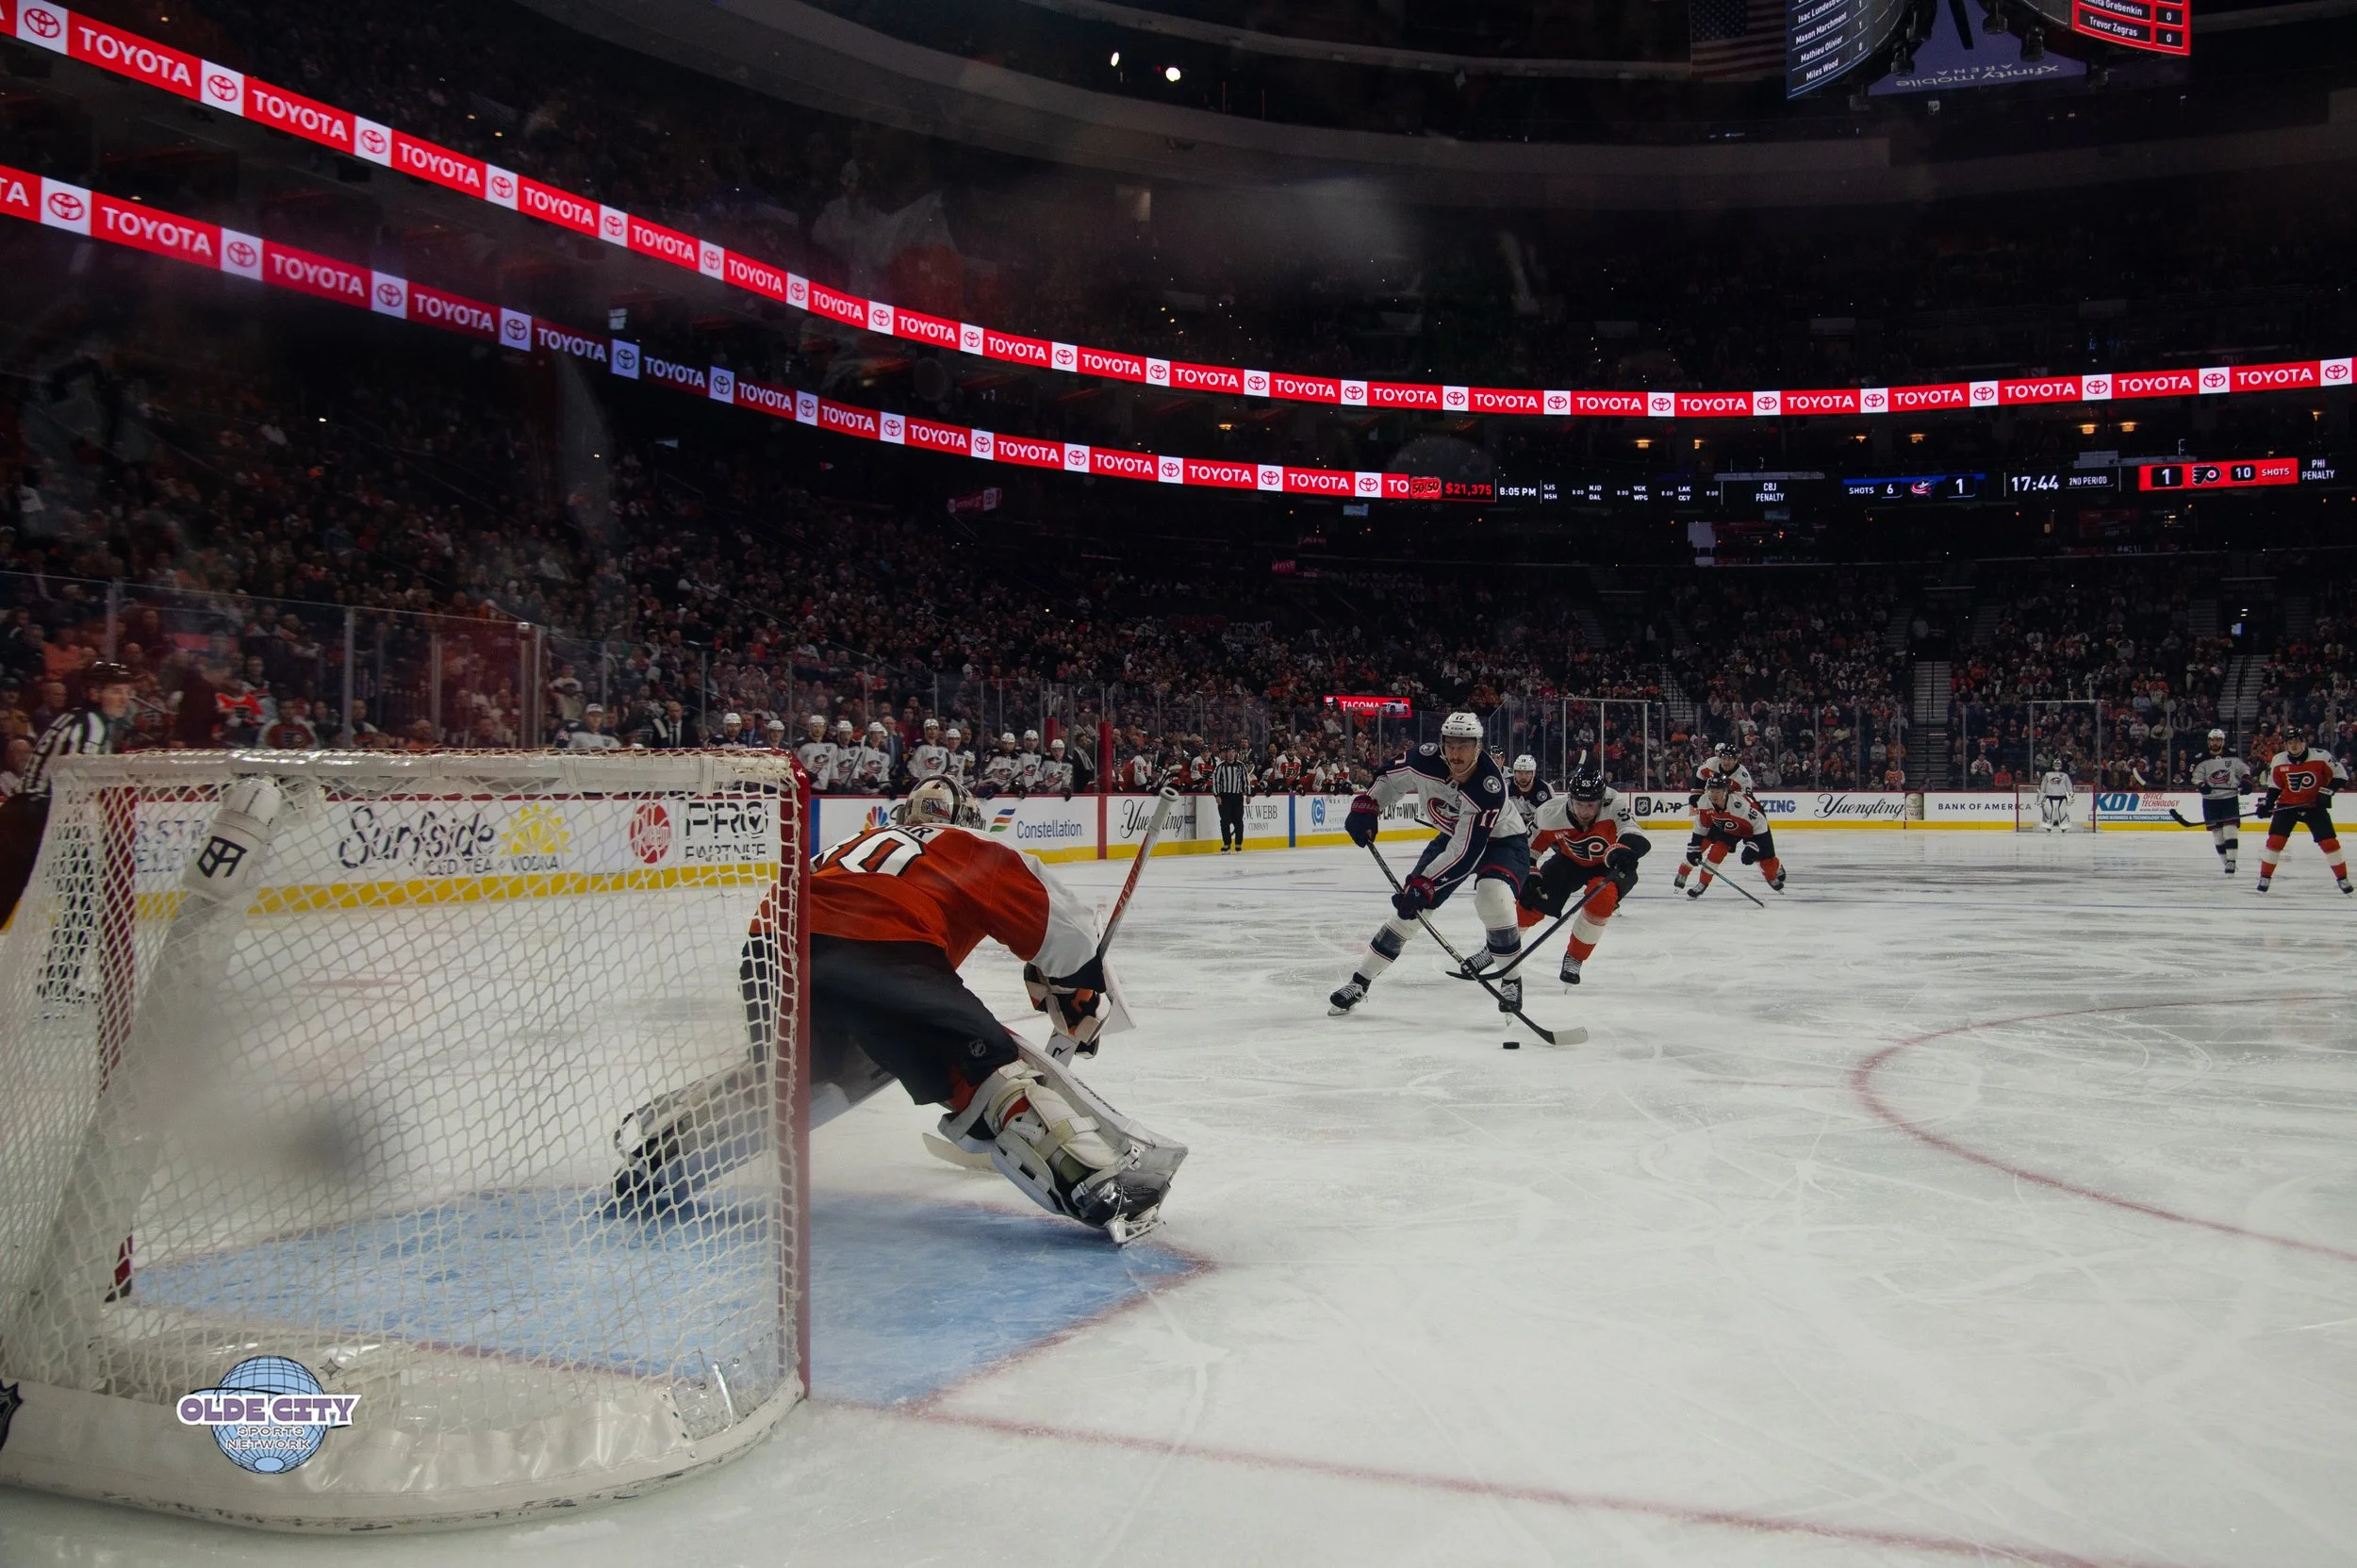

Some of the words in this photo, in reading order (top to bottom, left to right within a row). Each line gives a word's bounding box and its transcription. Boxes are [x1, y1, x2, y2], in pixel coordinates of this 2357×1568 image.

[2105, 0, 2143, 16] Grebenkin
[2166, 12, 2172, 21] 0
[1795, 30, 1816, 44] Mason
[1816, 11, 1847, 35] Marchment
[2089, 16, 2112, 30] Trevor
[2112, 23, 2138, 37] Zegras
[2166, 34, 2172, 42] 0
[1800, 46, 1824, 63] Mathieu
[1824, 36, 1843, 51] Olivier
[1805, 67, 1822, 81] Miles
[1822, 58, 1838, 73] Wood
[1936, 63, 2013, 76] ARENA
[1981, 64, 2060, 79] xfinity
[1896, 74, 1976, 88] mobile
[78, 26, 192, 87] TOYOTA
[253, 90, 348, 141] TOYOTA
[399, 142, 481, 188] TOYOTA
[523, 186, 595, 226] TOYOTA
[633, 225, 696, 261] TOYOTA
[728, 259, 783, 293] TOYOTA
[813, 290, 864, 321] TOYOTA
[898, 316, 956, 343] TOYOTA
[988, 337, 1047, 360] TOYOTA
[1082, 355, 1141, 376] TOYOTA
[1176, 369, 1239, 388] TOYOTA
[1275, 379, 1335, 398] TOYOTA
[1374, 388, 1437, 404] TOYOTA
[1475, 393, 1538, 409] TOYOTA
[1576, 397, 1642, 411] TOYOTA
[1681, 398, 1747, 412] TOYOTA
[1787, 395, 1854, 409] TOYOTA
[1894, 389, 1964, 404] TOYOTA
[2004, 382, 2076, 399] TOYOTA
[2118, 376, 2193, 392] TOYOTA
[2237, 369, 2314, 386] TOYOTA
[101, 206, 212, 256] TOYOTA
[271, 253, 364, 298] TOYOTA
[415, 293, 494, 332] TOYOTA
[537, 327, 607, 363] TOYOTA
[644, 355, 705, 388] TOYOTA
[738, 381, 792, 411] TOYOTA
[822, 405, 875, 432] TOYOTA
[910, 425, 966, 448] TOYOTA
[998, 441, 1059, 462] TOYOTA
[1095, 454, 1153, 474] TOYOTA
[1189, 465, 1252, 483] TOYOTA
[1289, 473, 1349, 490] TOYOTA
[2311, 459, 2325, 469] PHI
[2162, 469, 2170, 485] 1
[2235, 467, 2251, 478] 10
[2261, 468, 2290, 476] SHOTS
[2301, 470, 2335, 480] PENALTY
[1763, 483, 1776, 491] CBJ
[1956, 478, 1964, 494] 1
[2011, 475, 2059, 491] 17:44
[2069, 477, 2082, 487] 2ND
[2083, 475, 2107, 486] PERIOD
[1413, 482, 1440, 494] 50/50
[1445, 482, 1492, 496] $21,375
[1499, 487, 1519, 497] 8:05
[1521, 487, 1537, 497] PM
[1849, 487, 1874, 495] SHOTS
[1887, 484, 1894, 495] 6
[1755, 492, 1785, 503] PENALTY
[1342, 701, 1380, 711] TACOMA
[1814, 793, 1904, 818] Yuengling
[2091, 792, 2140, 811] KDI
[1255, 804, 1278, 820] WEBB
[1396, 806, 1403, 817] TO
[1479, 808, 1500, 828] 17
[1016, 819, 1083, 838] Constellation
[1247, 822, 1269, 831] COMPANY
